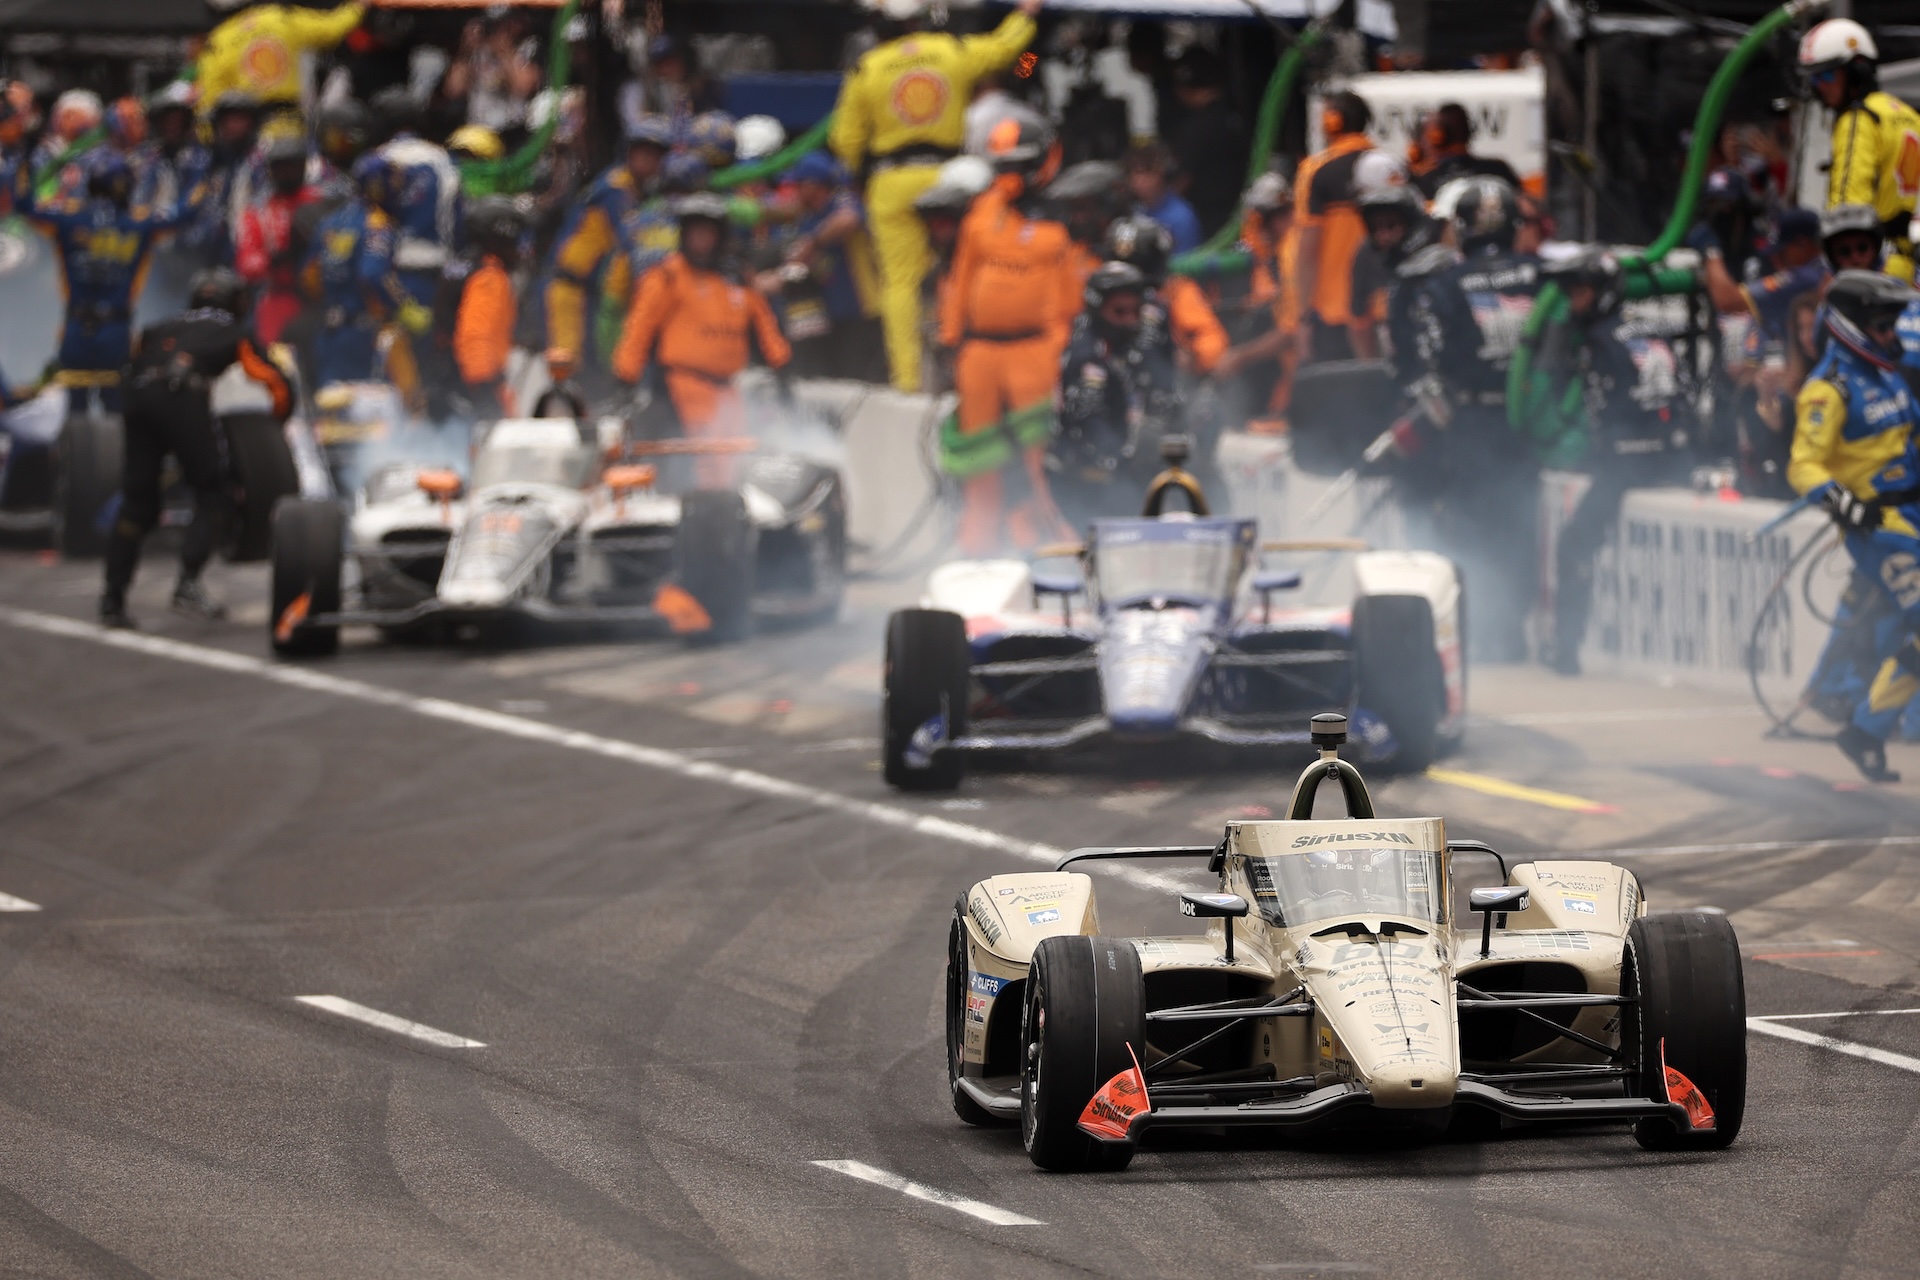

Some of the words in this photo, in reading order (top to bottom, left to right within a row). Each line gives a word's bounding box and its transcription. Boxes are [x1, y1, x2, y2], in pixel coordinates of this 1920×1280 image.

[1290, 831, 1415, 849] SiriusXM
[969, 897, 1002, 948] SiriusXM
[1331, 943, 1425, 965] 60
[1326, 960, 1440, 980] SiriusXM
[977, 977, 999, 993] CLIFFS
[1336, 974, 1434, 992] WALLEN
[1362, 989, 1427, 998] REMAX
